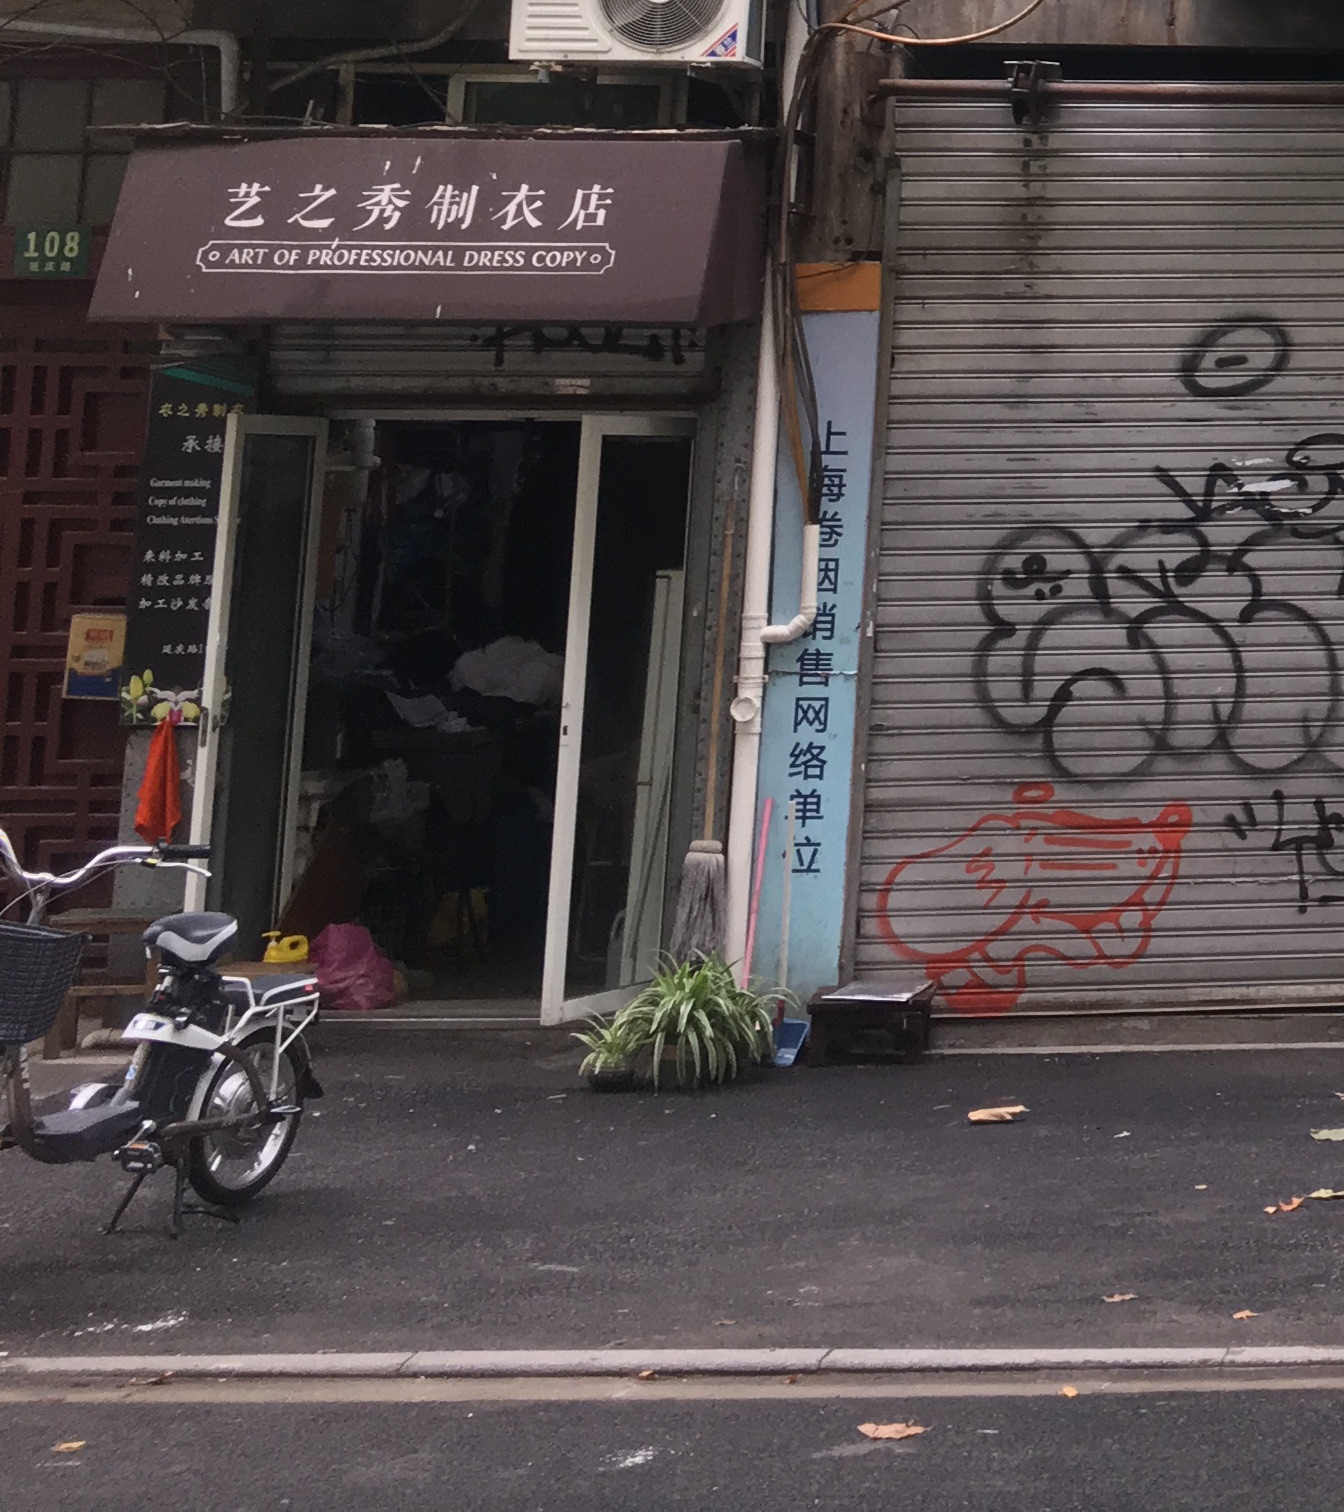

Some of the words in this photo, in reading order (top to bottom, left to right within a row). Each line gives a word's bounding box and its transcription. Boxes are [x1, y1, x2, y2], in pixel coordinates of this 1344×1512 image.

[224, 182, 615, 231] 艺之秀制衣店
[23, 231, 80, 258] 108
[225, 248, 269, 265] ART
[278, 249, 301, 265] OF
[307, 248, 456, 267] PROFESSIONAL
[463, 250, 525, 267] DRESS
[534, 250, 588, 268] COPY
[168, 496, 178, 506] of
